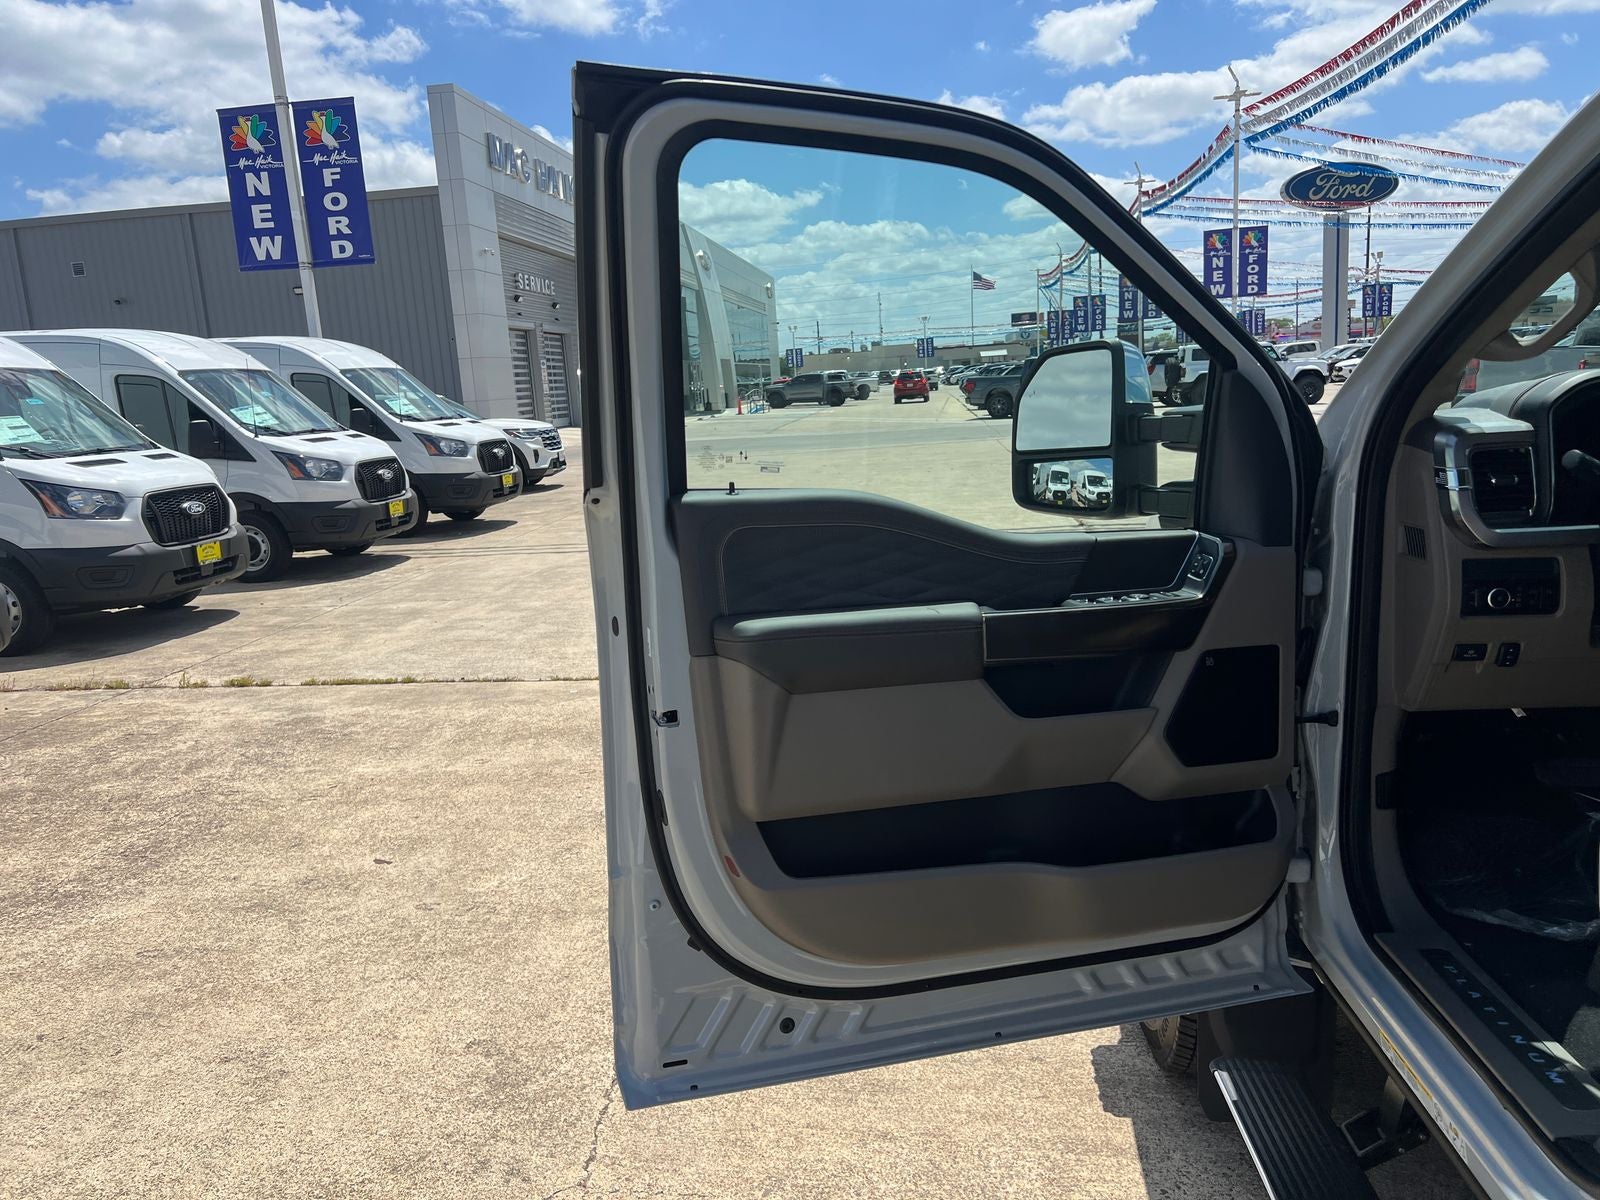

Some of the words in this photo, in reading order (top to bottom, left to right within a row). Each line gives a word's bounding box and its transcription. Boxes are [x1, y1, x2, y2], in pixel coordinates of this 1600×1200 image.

[486, 132, 531, 184] MAC
[1309, 171, 1375, 200] Ford
[245, 171, 283, 261] NEW
[322, 167, 354, 259] FORD
[518, 272, 556, 296] SERVICE
[1210, 256, 1226, 296] NEW
[1247, 254, 1260, 294] FORD
[1077, 310, 1086, 331] NEW
[1123, 291, 1134, 319] NEW
